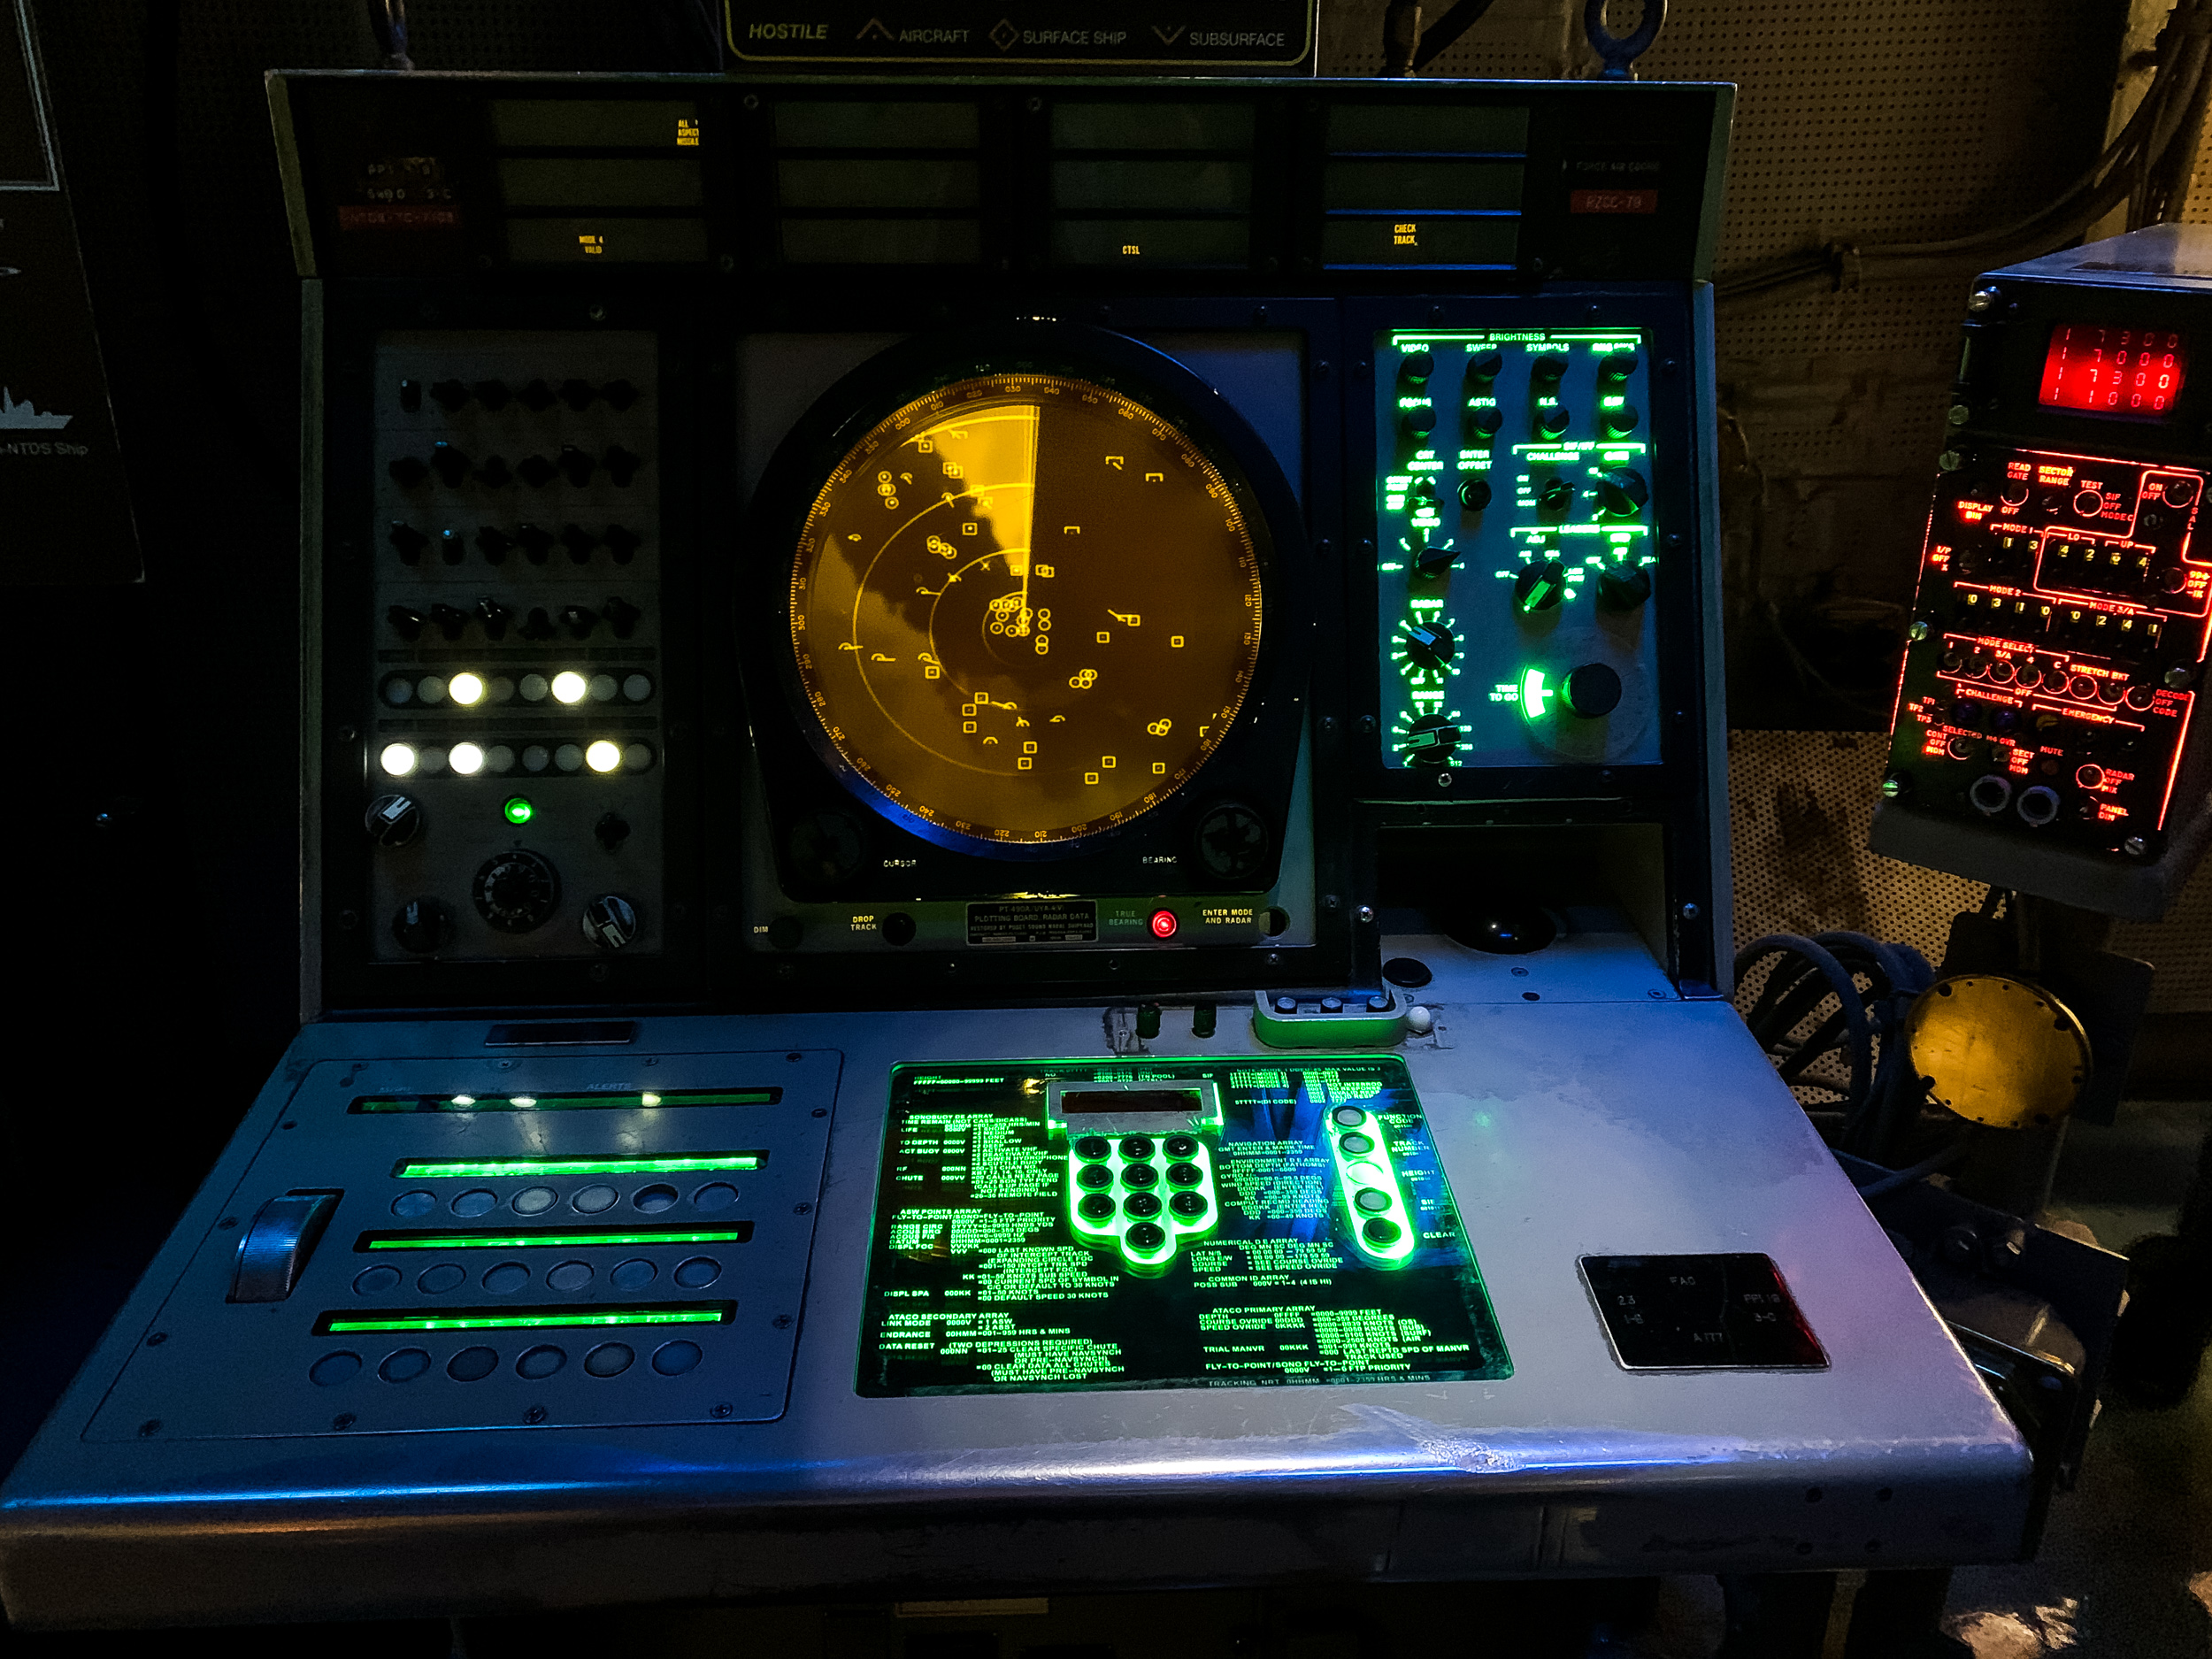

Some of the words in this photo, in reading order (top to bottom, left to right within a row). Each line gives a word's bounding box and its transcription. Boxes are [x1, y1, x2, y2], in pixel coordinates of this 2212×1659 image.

[749, 23, 829, 40] HOSTILE
[899, 28, 971, 43] AIRCRAFT
[1023, 29, 1090, 45] SURFACE
[1093, 30, 1126, 46] SHIP
[1190, 31, 1286, 47] SUBSURFACE
[1394, 224, 1416, 234] CHECK
[1394, 235, 1415, 245] TRACK
[1122, 245, 1140, 255] CTSL
[1489, 333, 1546, 342] BRIGHTNESS
[1401, 343, 1429, 353] VIDEO
[1043, 387, 1060, 396] 040
[930, 401, 944, 411] 010
[1468, 397, 1497, 406] ASTIG
[1118, 407, 1133, 419] 060
[895, 418, 910, 431] 000
[1151, 427, 1167, 442] 070
[1459, 449, 1490, 459] ENTER
[1526, 452, 1579, 461] CHALLENGE
[1407, 461, 1444, 471] CENTER
[1457, 460, 1493, 470] OFFSET
[2008, 462, 2032, 472] READ
[2007, 471, 2029, 480] GATE
[2039, 465, 2074, 478] SECTOR
[2039, 475, 2070, 486] RANGE
[2080, 480, 2104, 490] TEST
[1205, 483, 1218, 499] 090
[2148, 483, 2163, 492] ON
[2105, 492, 2122, 502] SIF
[2141, 492, 2162, 501] OFF
[1958, 501, 1993, 513] DISPLAY
[2001, 506, 2020, 516] OFF
[2103, 501, 2123, 511] OFF
[2101, 511, 2124, 520] MODE
[1225, 518, 1236, 533] 100
[2002, 523, 2027, 534] MODE
[1525, 534, 1546, 543] ADJ
[2068, 533, 2080, 541] LO
[2120, 540, 2134, 549] UP
[1932, 554, 1951, 563] OFF
[2187, 580, 2208, 588] OFF
[1990, 585, 2013, 595] MODE
[2089, 601, 2115, 612] MODE
[1977, 637, 2001, 649] MODE
[2002, 641, 2035, 653] SELECT
[1995, 649, 2012, 659] 3/A
[2070, 664, 2109, 678] STRETCH
[2111, 672, 2130, 681] BKT
[1965, 688, 2015, 704] CHALLENGE
[2015, 687, 2032, 697] OFF
[1488, 693, 1502, 702] TO
[1503, 693, 1518, 702] GO
[2155, 698, 2174, 707] OFF
[1909, 703, 1924, 713] TP2
[2153, 707, 2178, 718] CODE
[1916, 714, 1932, 724] TP3
[2062, 708, 2116, 725] EMERGENCY
[1926, 730, 1947, 740] CONT
[1943, 726, 1983, 740] SELECTED
[1930, 739, 1947, 748] OFF
[2000, 738, 2016, 747] OVR
[2012, 749, 2035, 759] SECT
[2040, 746, 2063, 757] MUTE
[2105, 768, 2135, 781] RADAR
[2104, 777, 2123, 786] OFF
[886, 783, 902, 797] 250
[2101, 785, 2118, 794] MIX
[1143, 792, 1157, 803] 180
[918, 805, 935, 818] 240
[2100, 803, 2129, 817] PANEL
[2098, 811, 2116, 821] DIM
[882, 858, 918, 869] CURSOR
[1142, 856, 1178, 864] BEARING
[1202, 909, 1227, 918] ENTER
[852, 915, 874, 924] DROP
[1109, 918, 1144, 926] BEARING
